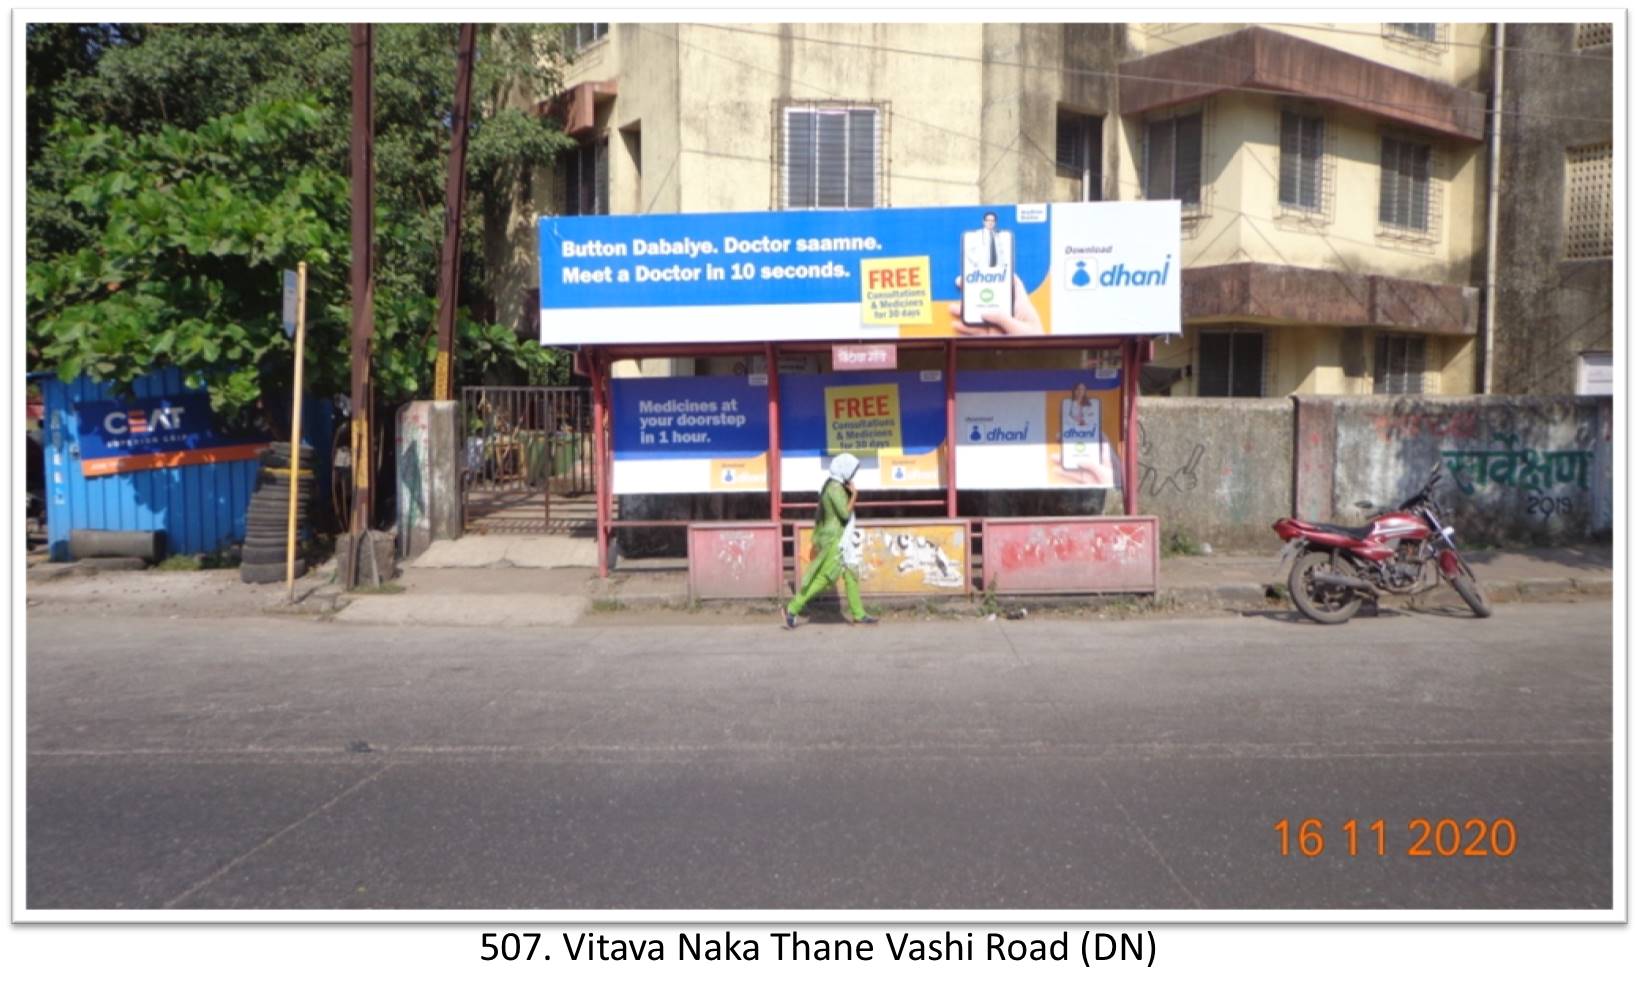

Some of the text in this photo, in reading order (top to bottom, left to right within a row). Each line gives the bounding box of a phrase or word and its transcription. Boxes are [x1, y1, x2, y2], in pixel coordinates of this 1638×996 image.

[562, 239, 627, 258] Button
[724, 235, 790, 254] Doctor
[796, 234, 882, 253] saamne.
[562, 260, 850, 284] Meet a Doctor in 10 seconds.
[868, 266, 922, 290] FREE
[966, 264, 1008, 283] dhani
[1100, 253, 1172, 287] dhani
[880, 299, 924, 309] Medicines
[639, 398, 738, 413] Medicines at
[833, 393, 891, 419] FREE
[103, 406, 186, 435] CEAT
[639, 412, 746, 429] your doorstep
[986, 420, 1030, 442] dhani
[640, 429, 711, 444] in 1 hour.
[846, 429, 894, 439] Medicines
